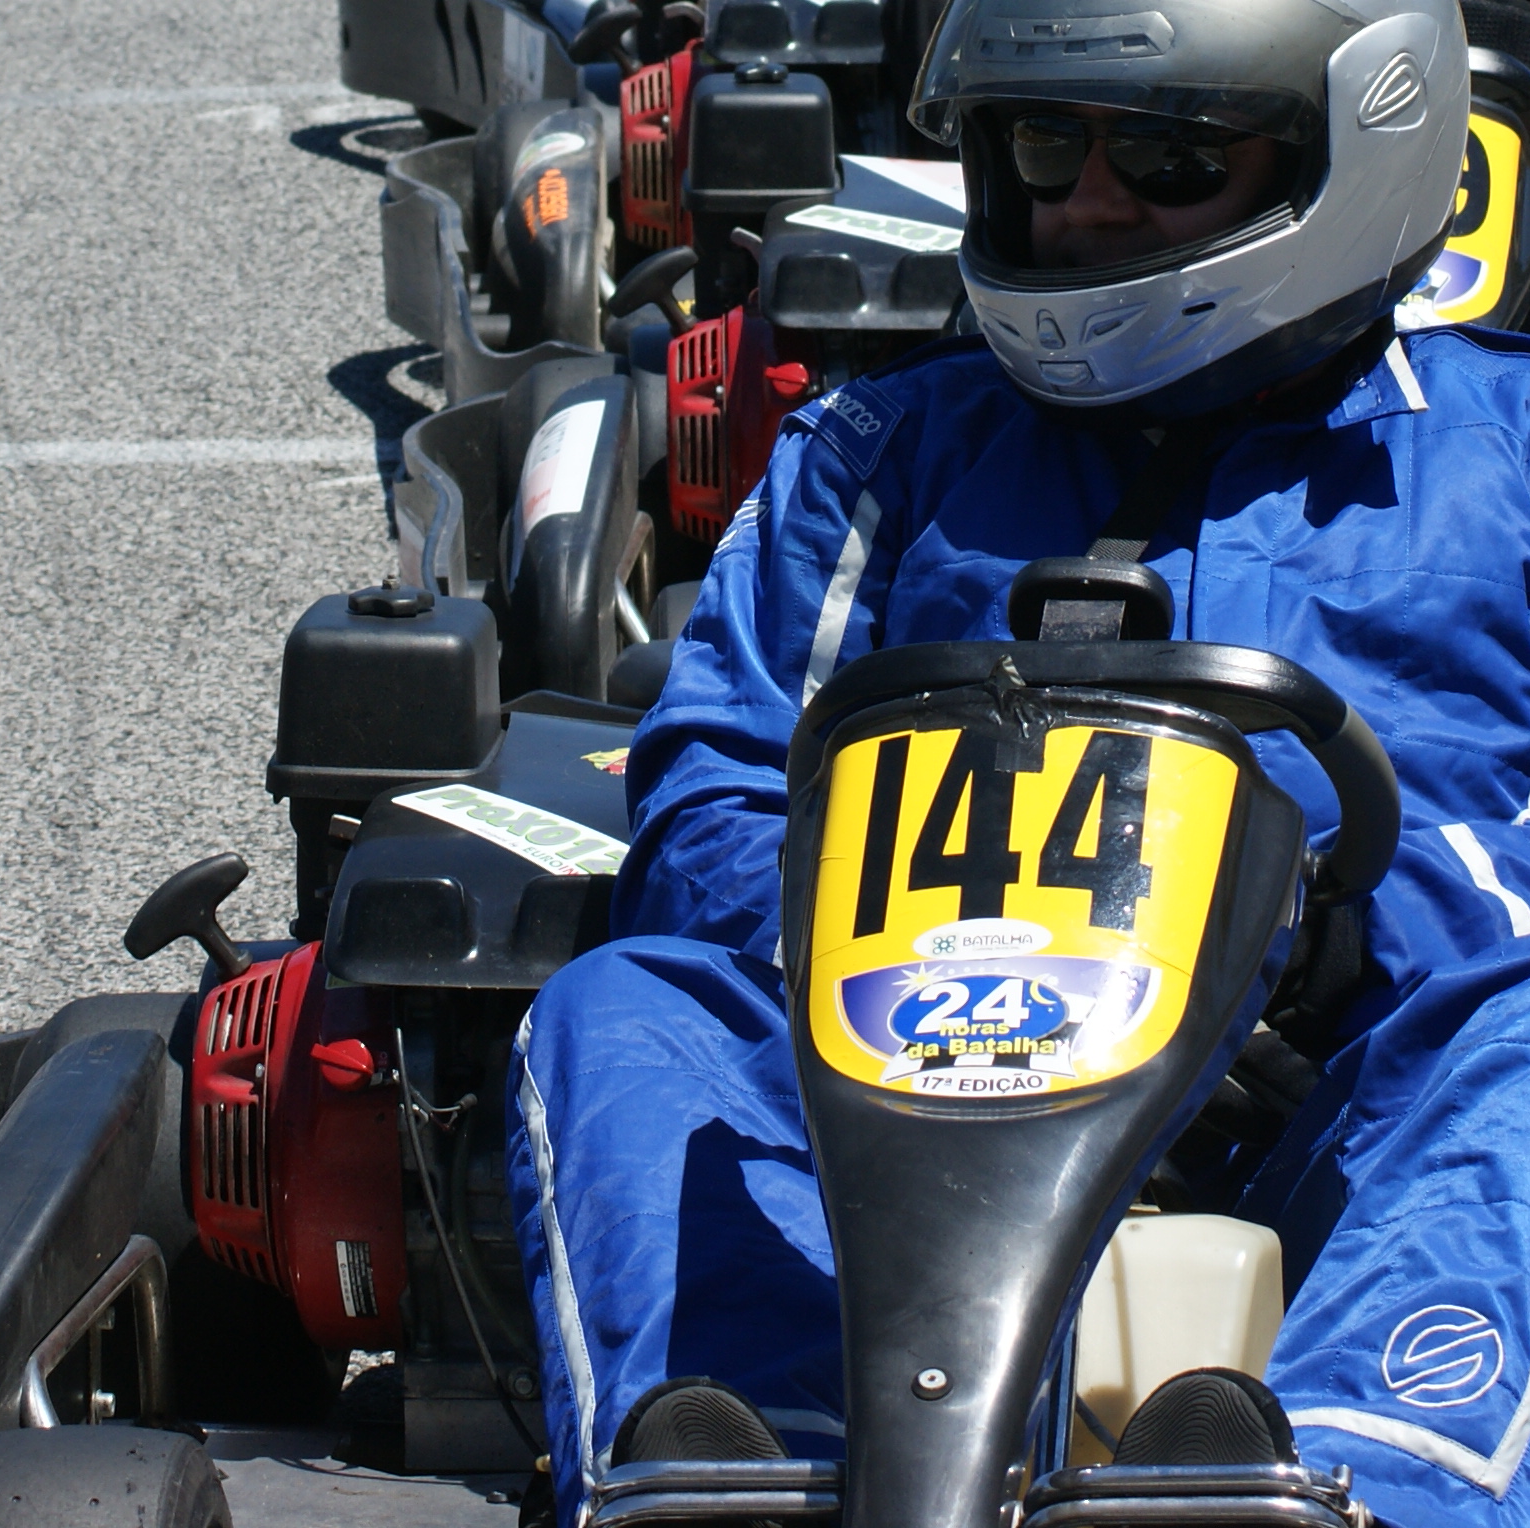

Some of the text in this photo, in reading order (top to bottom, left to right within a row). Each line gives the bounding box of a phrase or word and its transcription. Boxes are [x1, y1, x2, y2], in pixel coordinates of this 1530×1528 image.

[852, 729, 1153, 940] 144
[962, 933, 1033, 947] BATALHA
[914, 978, 1030, 1034] 24
[939, 1022, 1011, 1037] horas
[907, 1036, 1057, 1060] da Batalha
[958, 1072, 1044, 1094] EDIÇÃO
